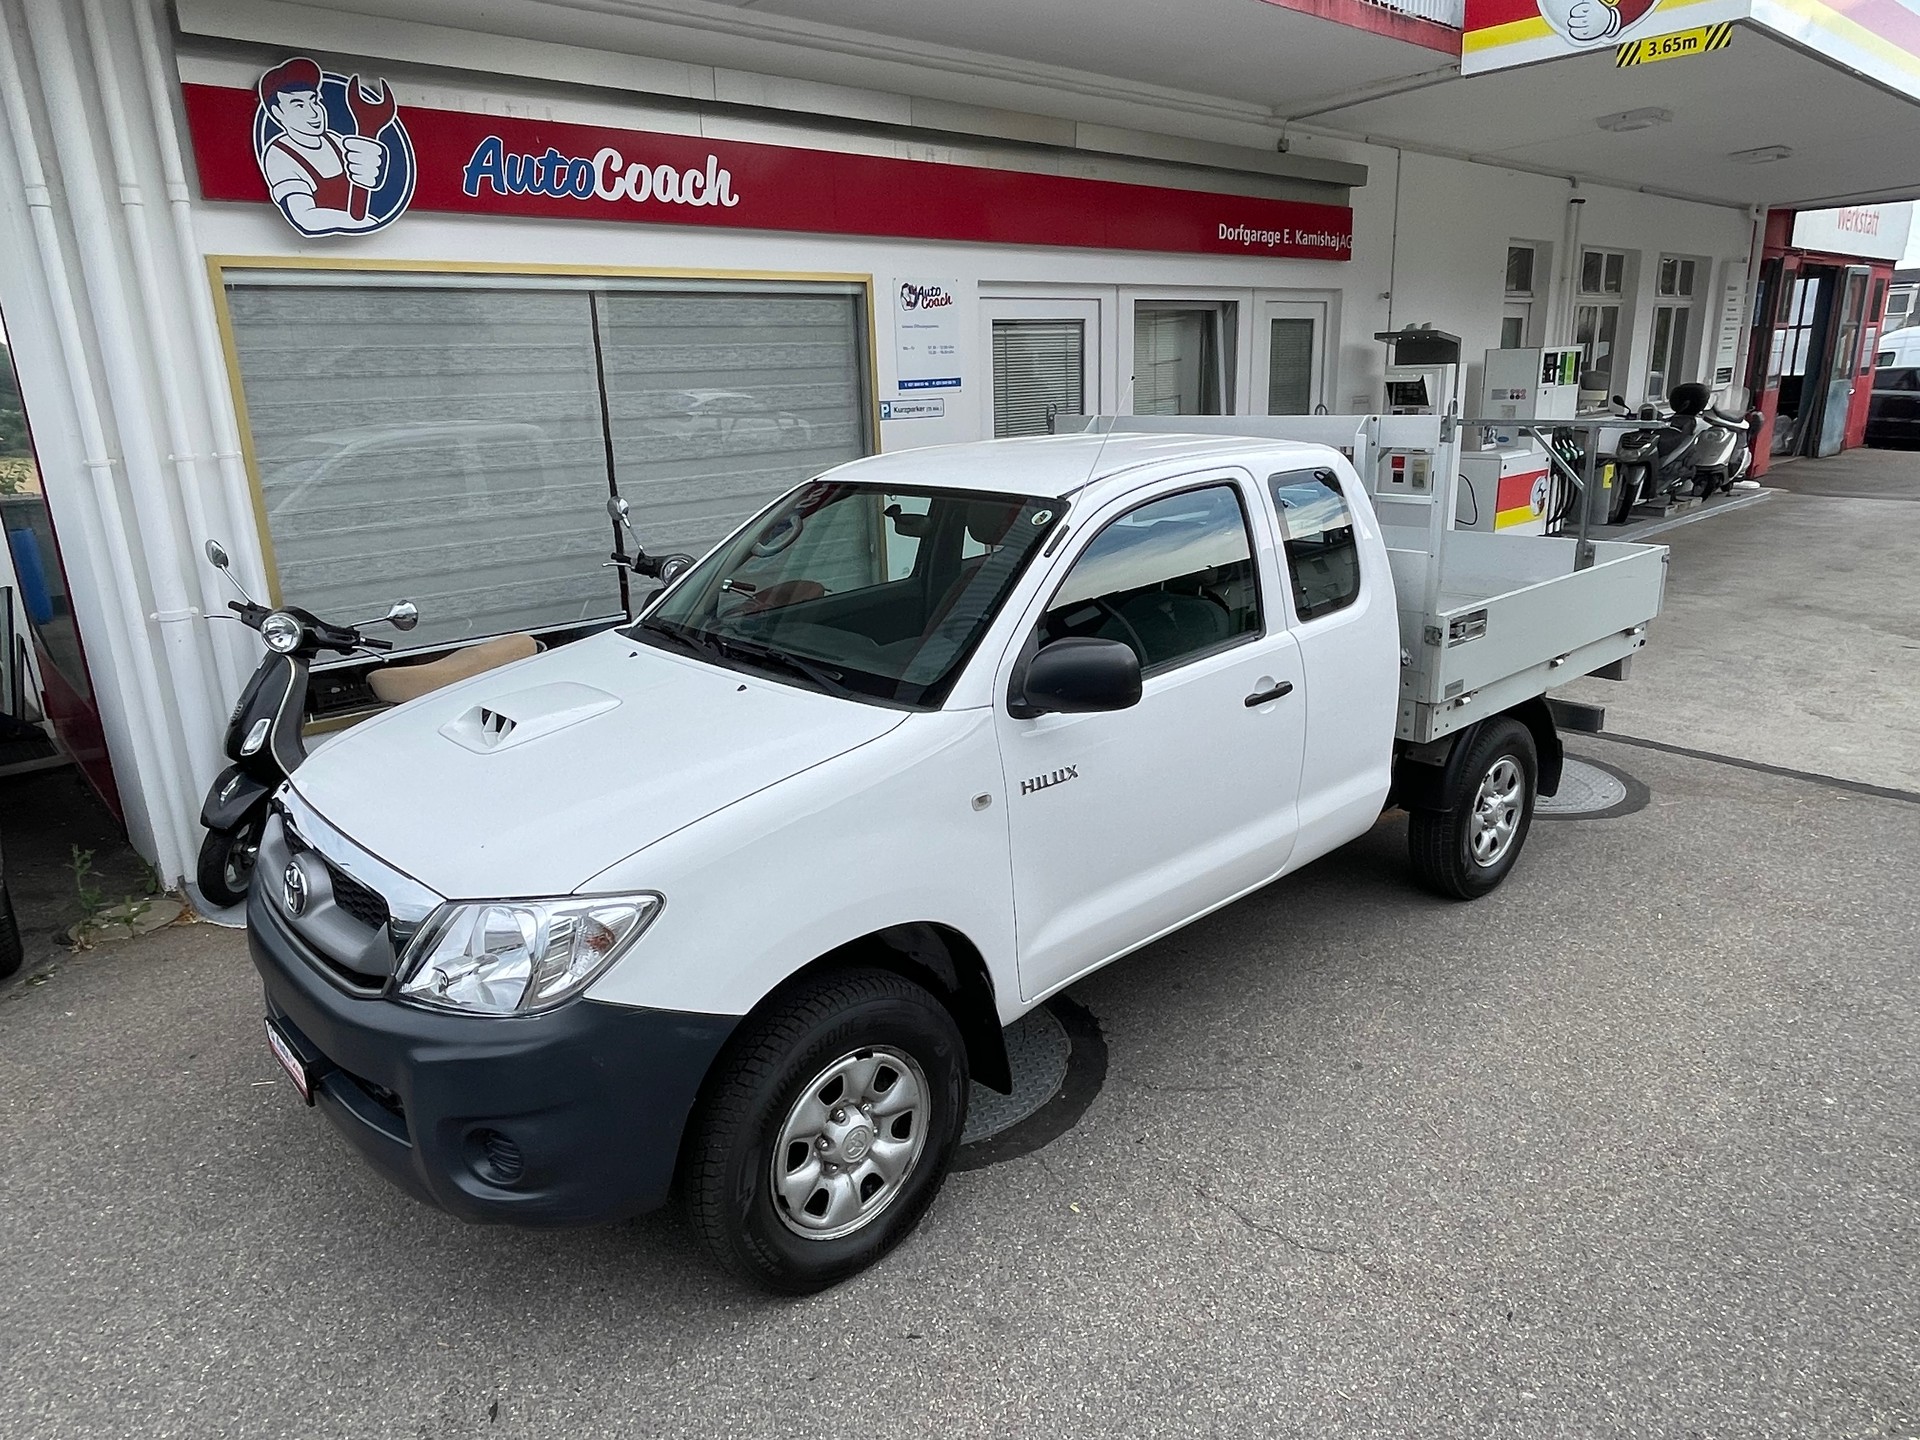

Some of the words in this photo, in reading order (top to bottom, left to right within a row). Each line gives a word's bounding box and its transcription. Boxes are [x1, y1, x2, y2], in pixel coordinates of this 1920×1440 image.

[1648, 36, 1697, 57] 3.65m
[1838, 208, 1880, 237] Werkstatt
[1218, 222, 1281, 247] Dorfgarage
[1283, 228, 1293, 244] E.
[918, 285, 942, 298] Auto
[921, 292, 953, 310] Coach
[893, 406, 925, 414] Kurzparker
[1020, 763, 1079, 796] HILUX
